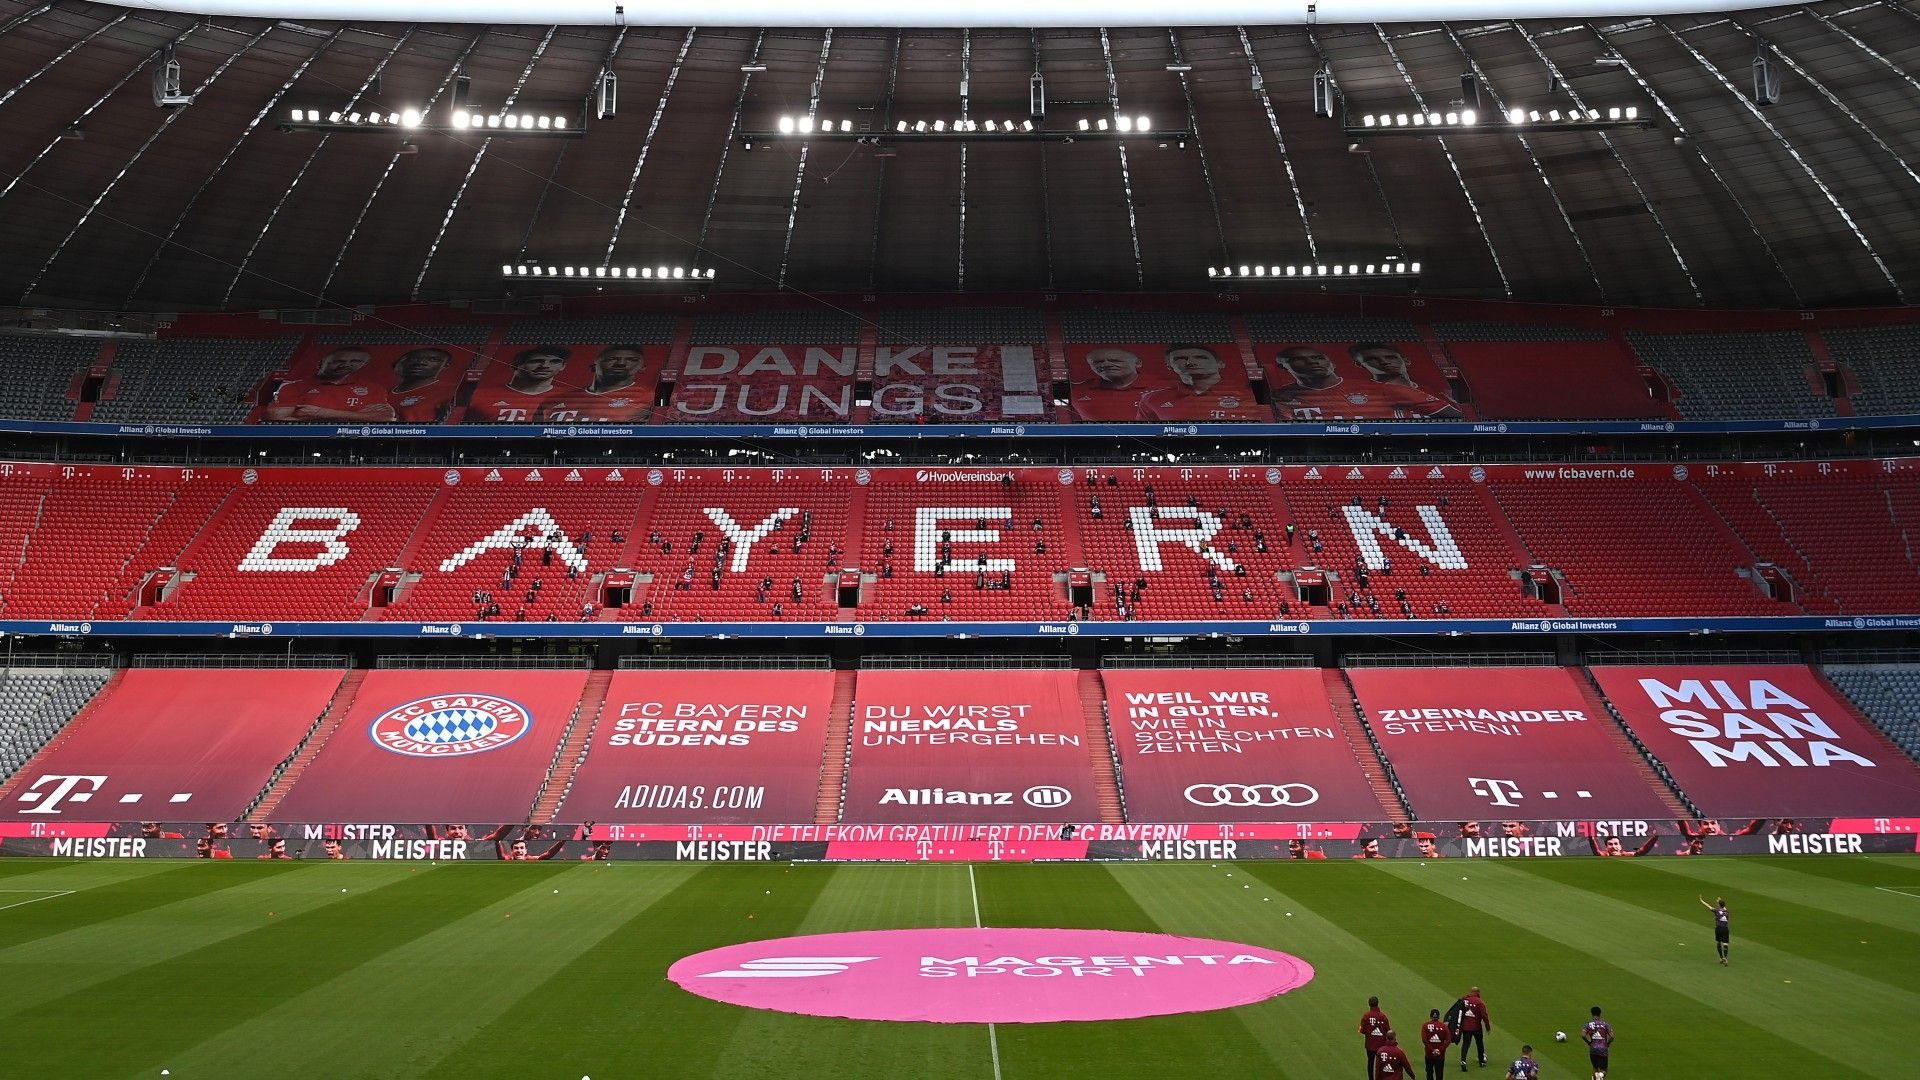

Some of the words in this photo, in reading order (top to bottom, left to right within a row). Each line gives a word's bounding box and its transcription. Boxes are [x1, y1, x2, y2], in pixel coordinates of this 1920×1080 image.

[1045, 294, 1057, 302] 327
[1600, 309, 1614, 317] 324
[157, 321, 172, 329] 332
[684, 346, 978, 376] DANKE
[677, 383, 982, 417] JUNGS
[991, 426, 1014, 434] Allianz
[1164, 426, 1187, 434] Allianz
[1326, 425, 1350, 433] Allianz
[1474, 424, 1497, 432] Allianz
[1640, 422, 1665, 431] Allianz
[1784, 420, 1808, 428] Allianz
[119, 426, 144, 434] Allianz
[179, 427, 212, 435] Investors
[337, 427, 360, 435] Allianz
[371, 427, 394, 435] Global
[395, 427, 426, 435] Investors
[543, 427, 566, 435] Allianz
[577, 427, 600, 435] Global
[602, 427, 633, 435] Investors
[774, 427, 796, 435] Allianz
[808, 427, 830, 435] Global
[832, 427, 864, 435] Investors
[50, 624, 78, 632] Allianz
[233, 624, 260, 633] Allianz
[422, 625, 449, 634] Allianz
[623, 625, 650, 634] Allianz
[825, 625, 853, 634] Allianz
[1039, 625, 1067, 633] Allianz
[1270, 624, 1297, 632] Allianz
[1512, 622, 1540, 630] Allianz
[1552, 622, 1578, 630] Global
[1580, 621, 1617, 630] Investors
[1125, 692, 1202, 704] WEIL
[1209, 692, 1270, 704] WIR
[1638, 678, 1810, 710] MIA
[390, 705, 425, 722] FC
[431, 697, 520, 724] BAYERN
[620, 702, 663, 717] FC
[674, 703, 808, 718] BAYERN
[866, 706, 911, 718] DU
[922, 704, 1032, 718] WIRST
[1129, 707, 1158, 718] IN
[1378, 708, 1588, 722] ZUEINANDER
[614, 718, 724, 732] STERN
[734, 720, 799, 732] DES
[864, 718, 1018, 732] NIEMALS
[1130, 719, 1188, 730] WIE
[1198, 718, 1226, 728] IN
[1384, 720, 1522, 736] STEHEN!
[1660, 710, 1841, 739] SAN
[608, 730, 750, 746] SÜDENS
[863, 732, 1080, 746] UNTERGEHEN
[1135, 728, 1335, 742] SCHLECHTEN
[380, 730, 511, 754] MÜNCHEN
[1137, 742, 1242, 754] ZEITEN
[1688, 740, 1877, 767] MIA
[615, 784, 764, 809] ADIDAS.COM
[878, 788, 1014, 805] Allianz
[752, 826, 784, 840] DIE
[792, 826, 883, 840] TELEKOM
[890, 825, 1014, 840] GRATULIERT
[1018, 824, 1062, 840] DEM
[1100, 824, 1188, 840] BAYERN!
[52, 838, 146, 857] MEISTER
[372, 840, 466, 859] MEISTER
[1142, 840, 1237, 859] MEISTER
[1466, 837, 1561, 856] MEISTER
[1768, 834, 1863, 853] MEISTER
[676, 841, 771, 860] MEISTER
[920, 955, 1276, 966] MAGENTA
[918, 966, 1156, 977] SPORT
